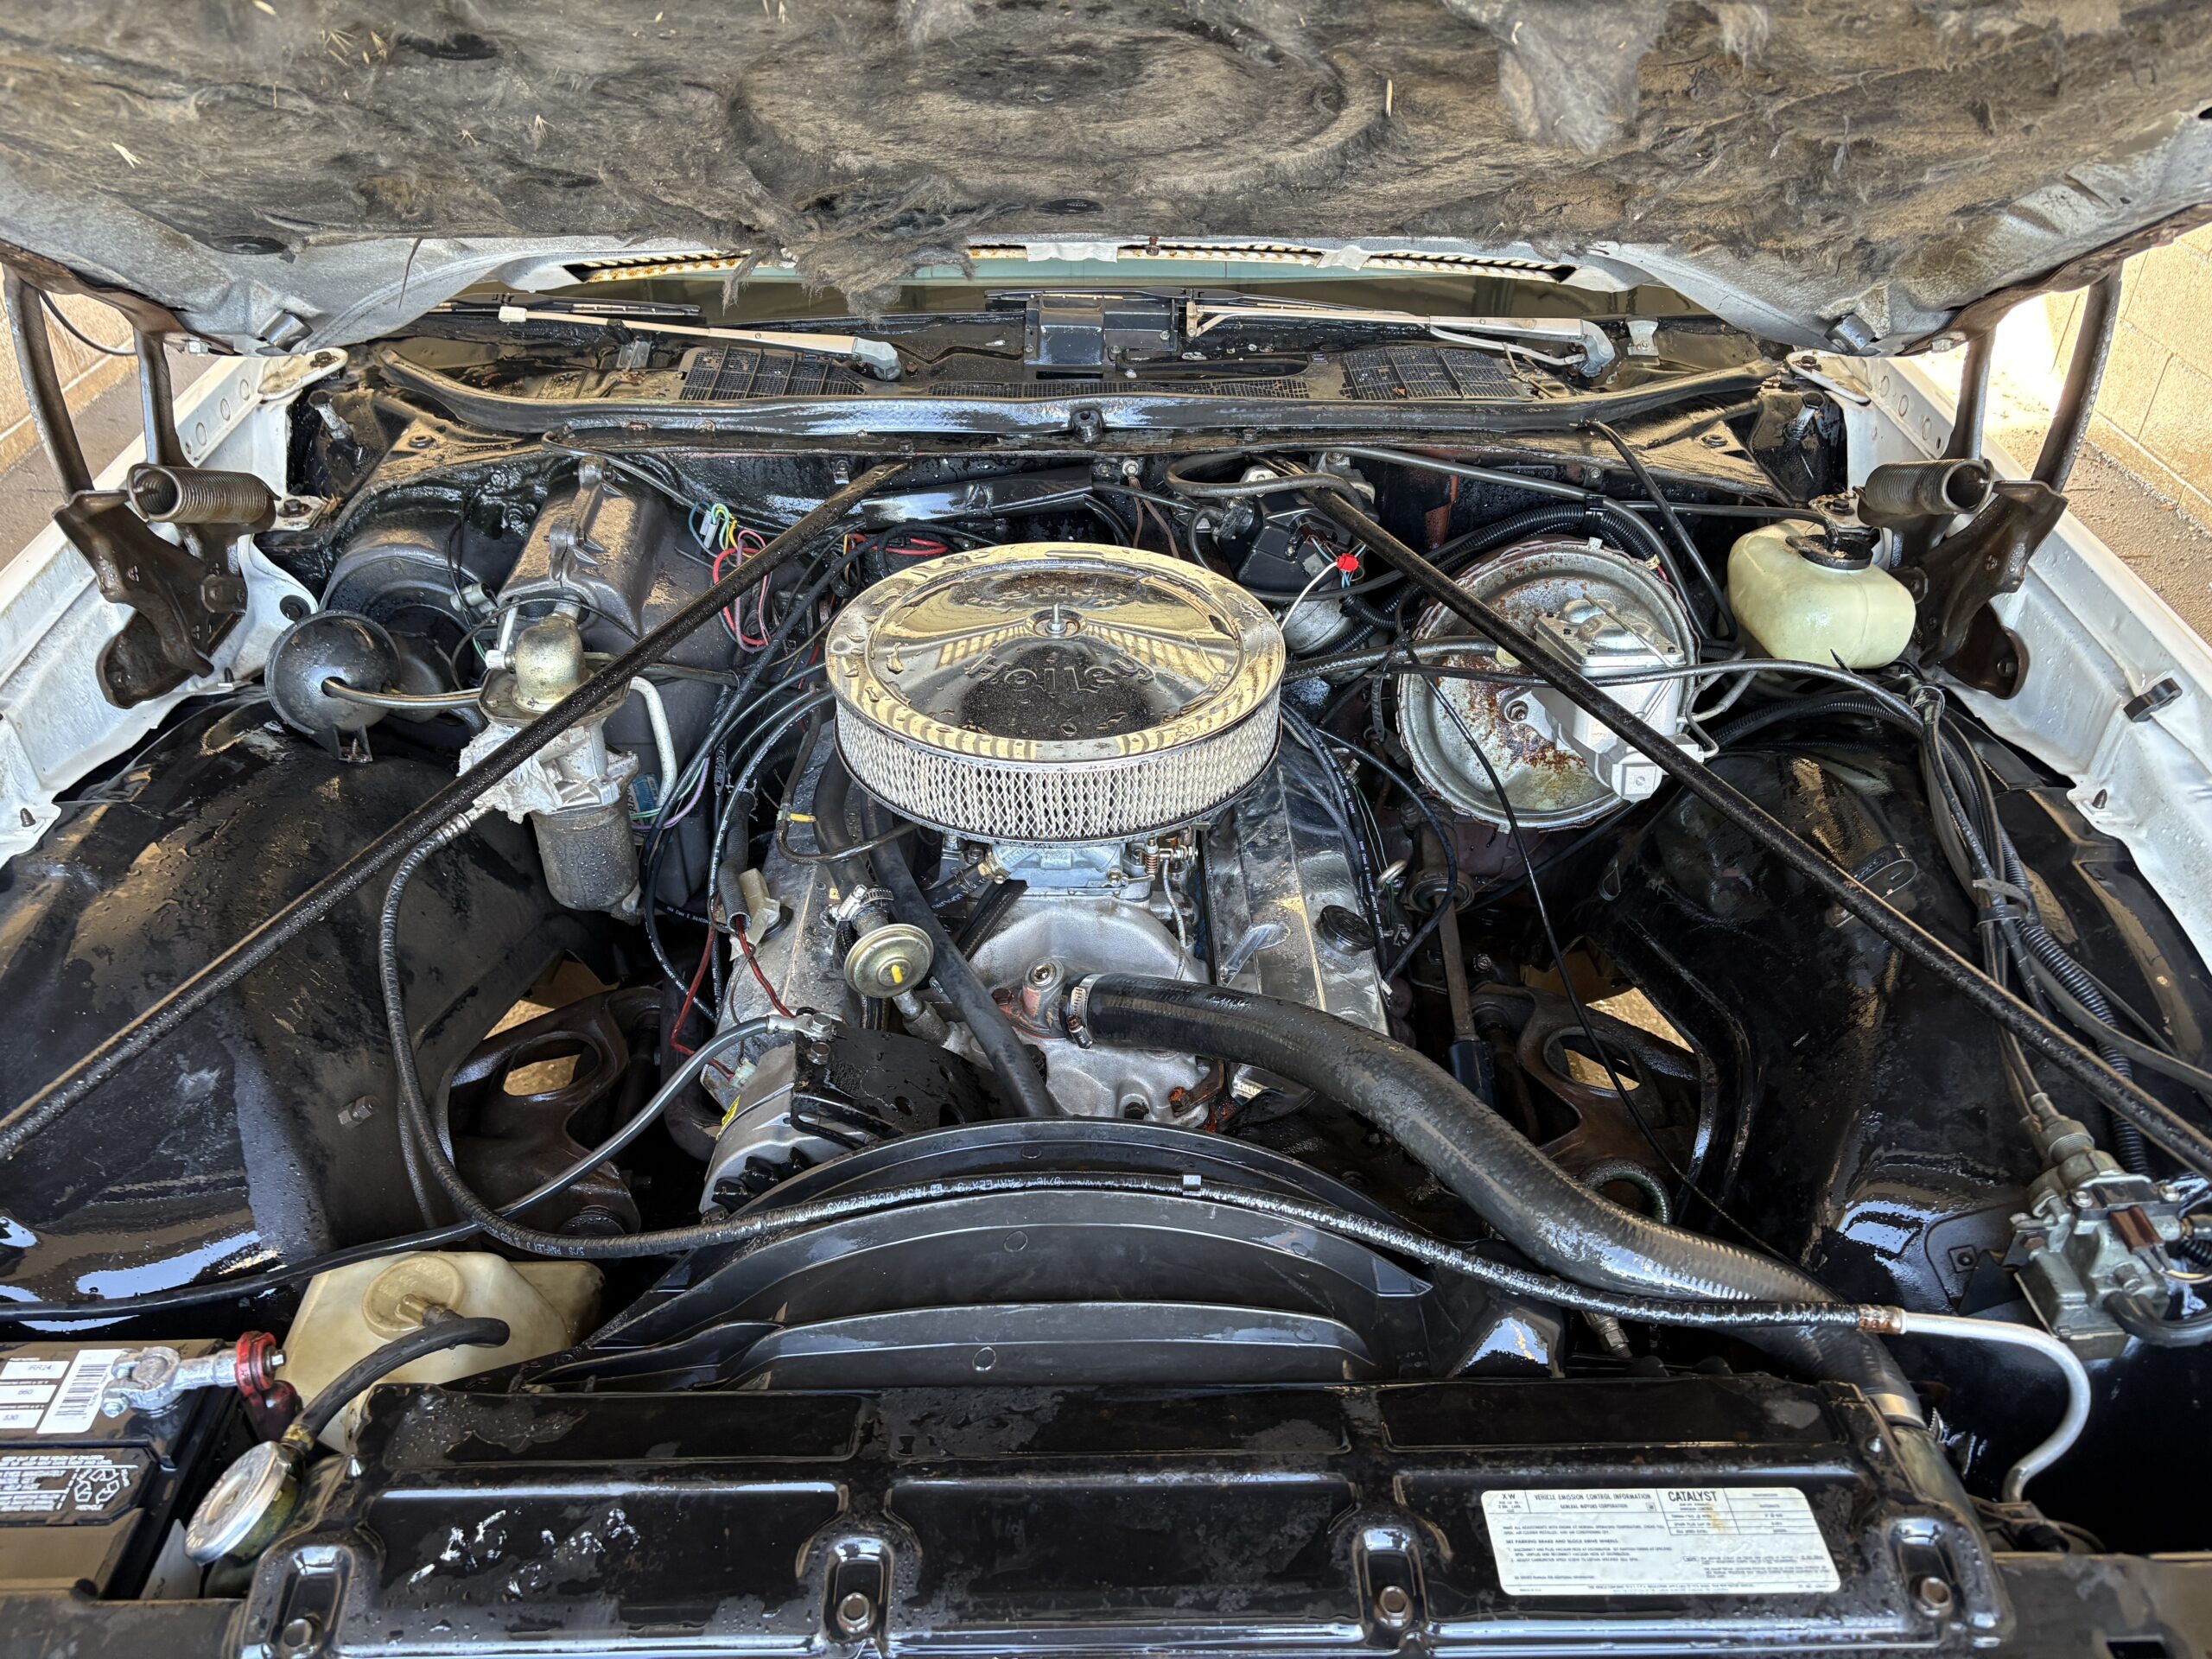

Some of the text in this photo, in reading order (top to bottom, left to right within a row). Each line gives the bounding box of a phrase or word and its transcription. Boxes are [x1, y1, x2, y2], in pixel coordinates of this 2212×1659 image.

[964, 652, 1157, 695] Holley
[1336, 770, 1346, 787] JACKET
[1348, 801, 1357, 815] CORE
[1366, 873, 1375, 893] SILICONE
[1370, 895, 1379, 912] JACKET
[662, 963, 676, 980] JACKET
[676, 980, 685, 990] MAG
[1668, 1491, 1717, 1502] CATALYST
